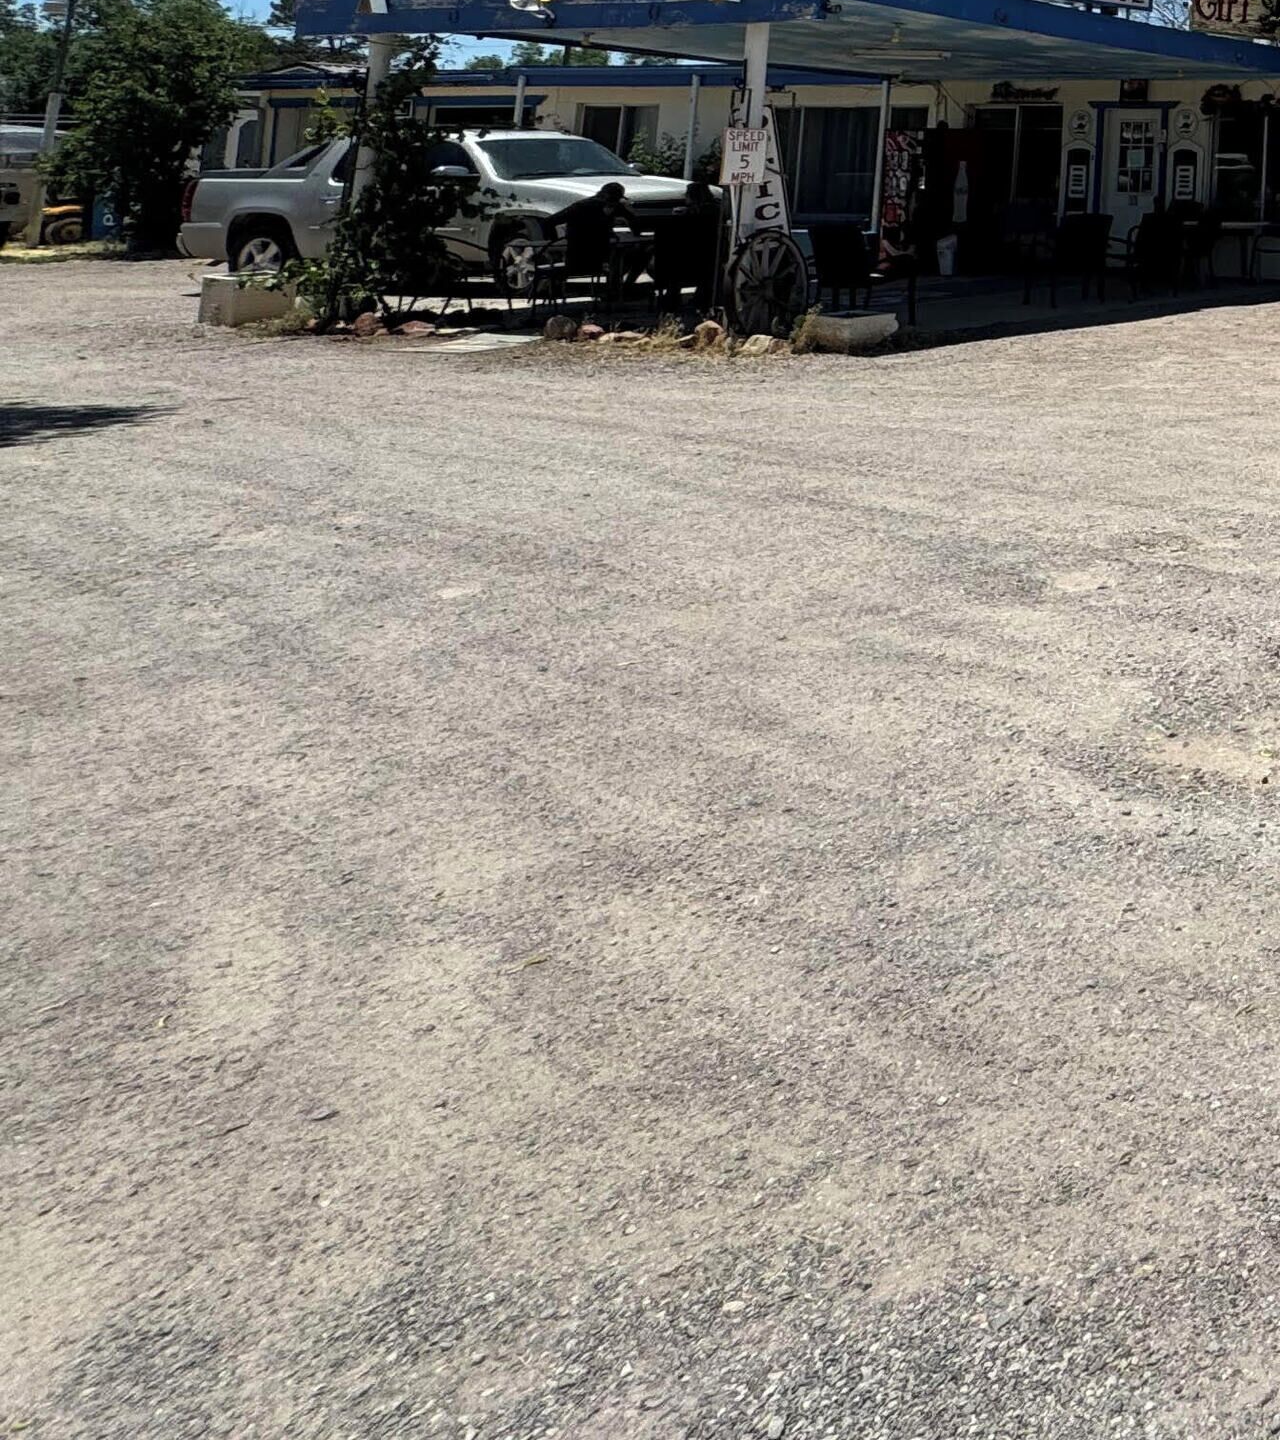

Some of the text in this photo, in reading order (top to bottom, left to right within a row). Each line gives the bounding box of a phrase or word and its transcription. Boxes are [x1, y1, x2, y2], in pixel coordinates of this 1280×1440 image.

[728, 130, 765, 142] SPEED
[731, 142, 759, 152] LIMIT
[740, 155, 750, 169] 5
[730, 172, 755, 182] MPH
